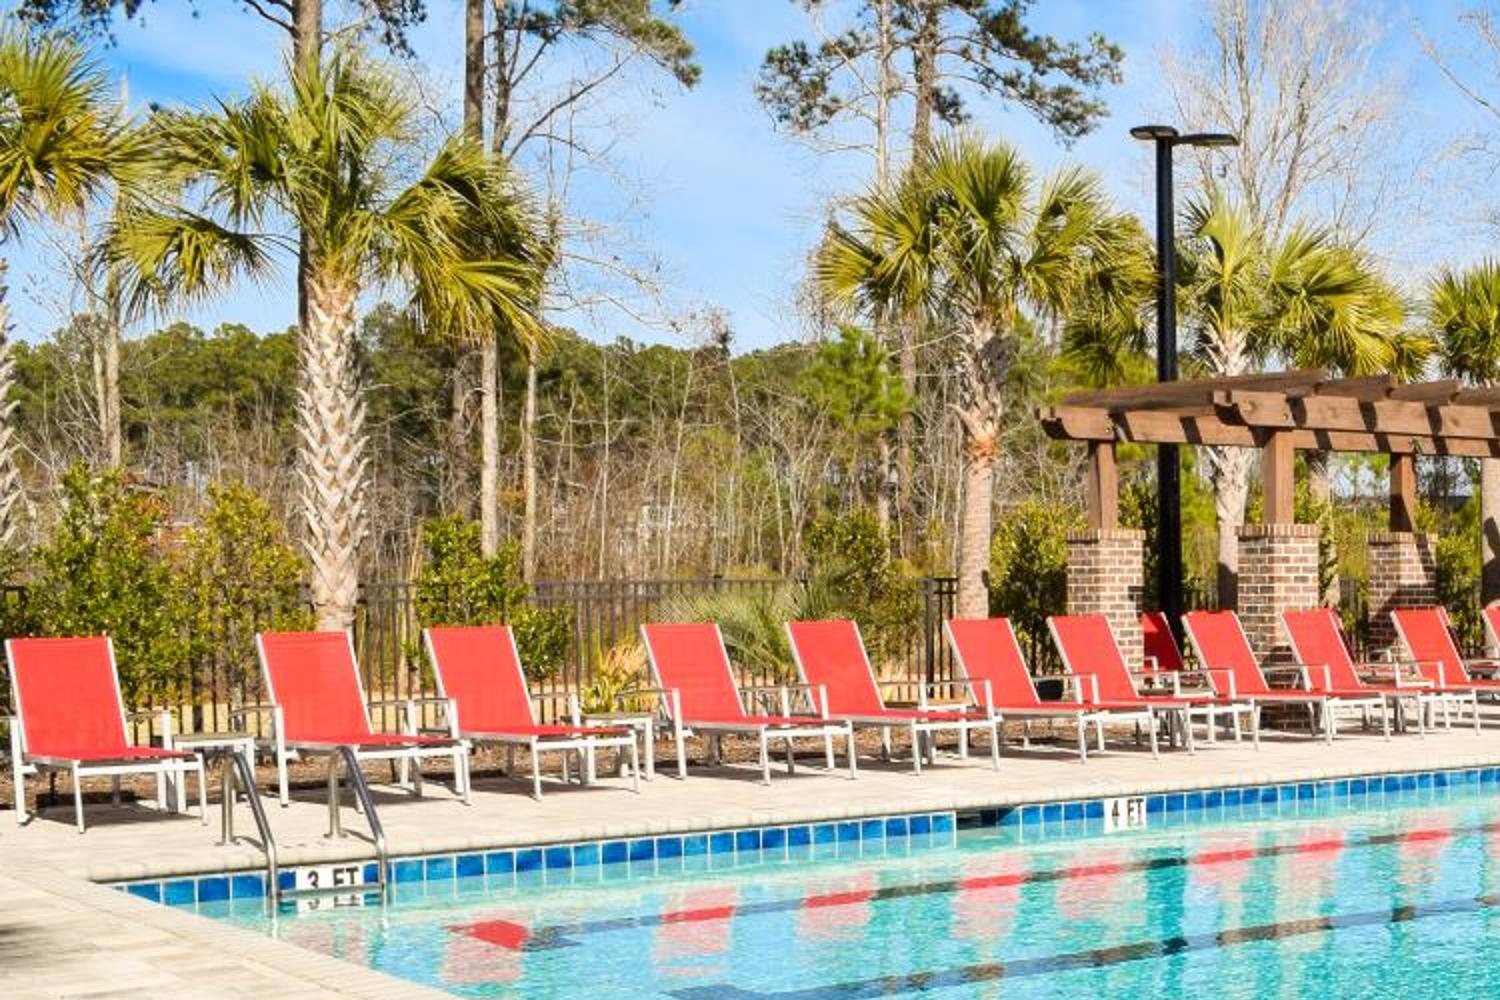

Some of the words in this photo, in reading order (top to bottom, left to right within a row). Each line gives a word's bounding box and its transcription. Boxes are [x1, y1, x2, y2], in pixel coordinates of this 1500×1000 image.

[1111, 799, 1120, 822] 4
[1127, 798, 1144, 822] FT
[307, 870, 320, 889] 3
[332, 866, 360, 886] FT
